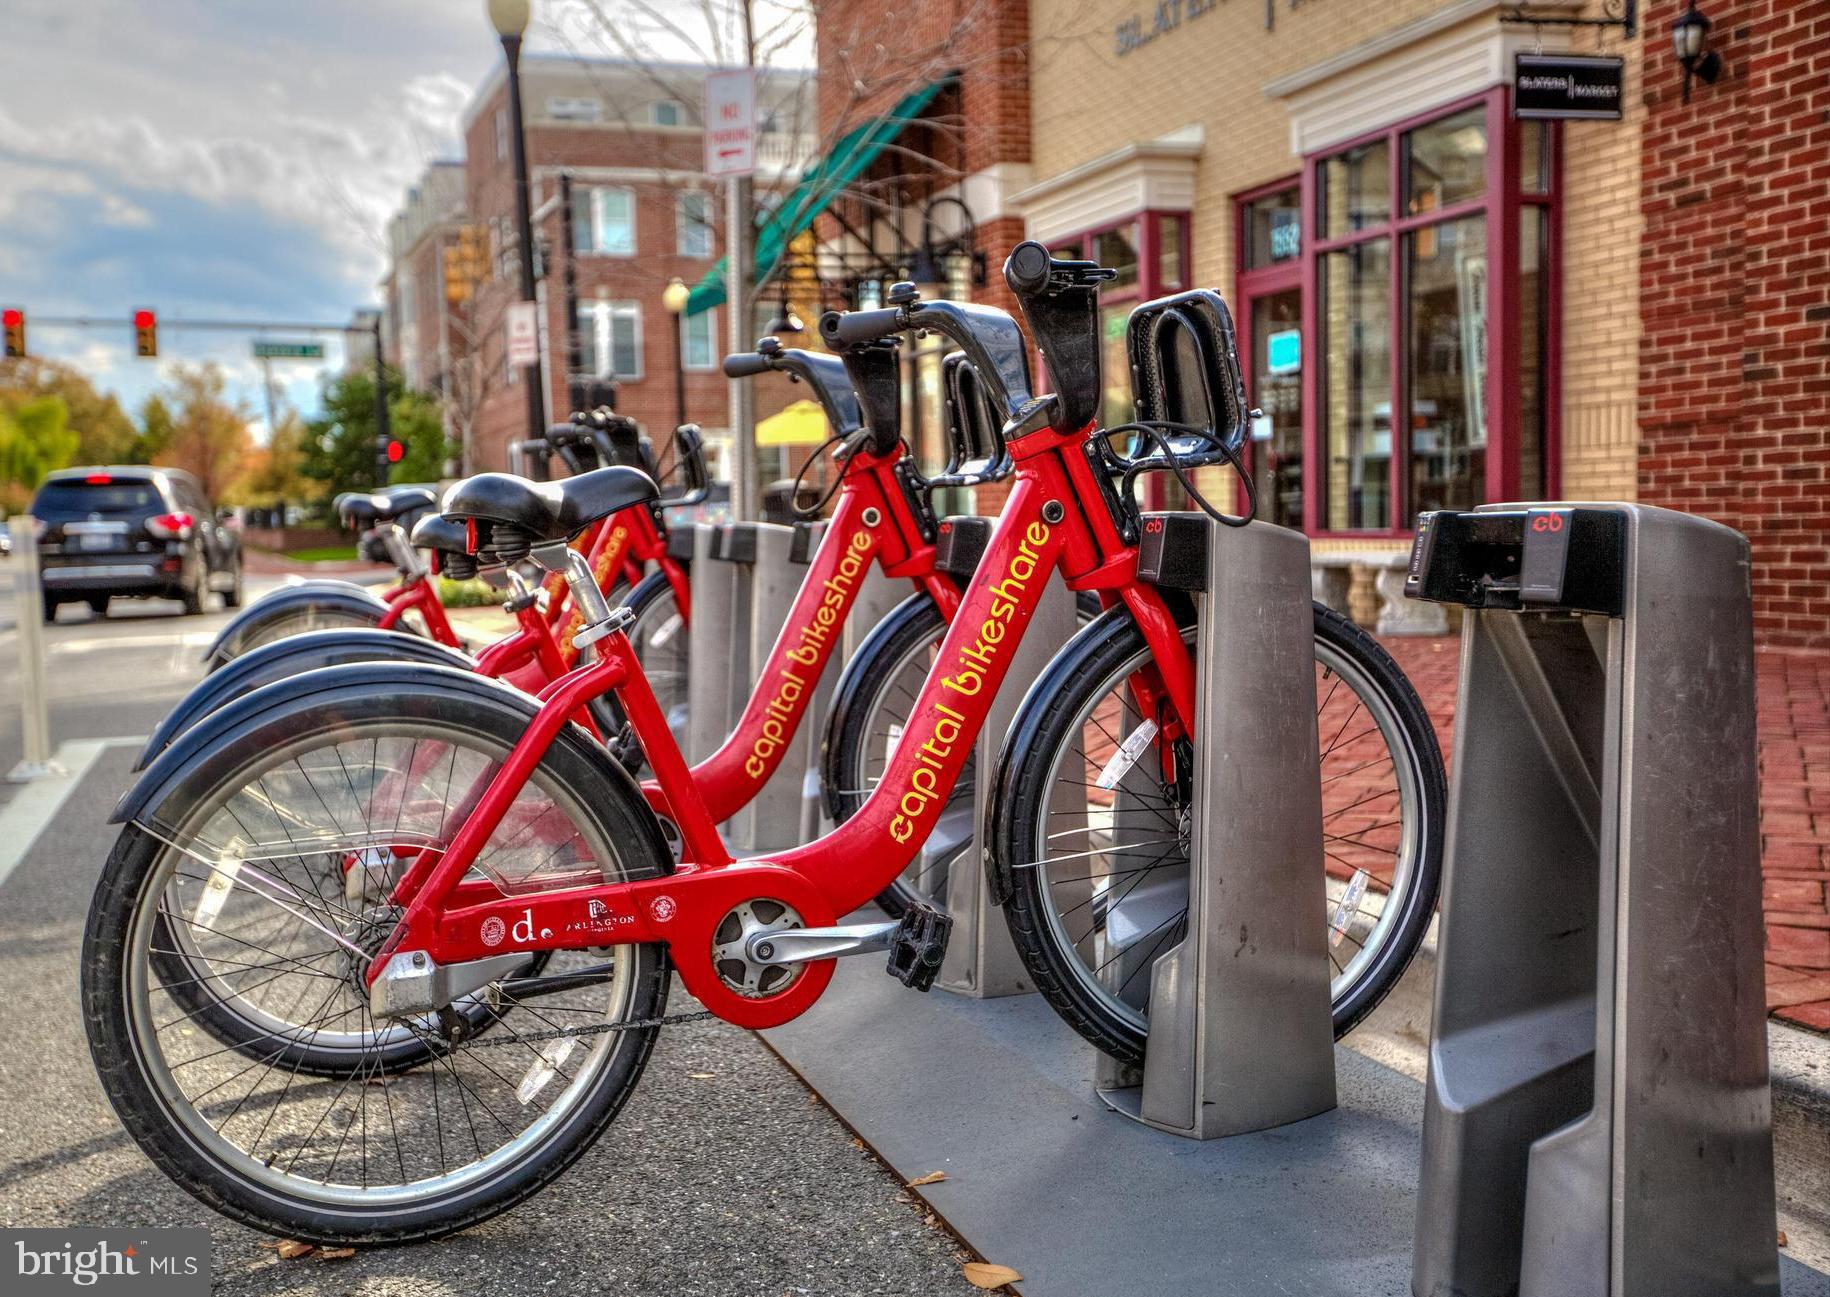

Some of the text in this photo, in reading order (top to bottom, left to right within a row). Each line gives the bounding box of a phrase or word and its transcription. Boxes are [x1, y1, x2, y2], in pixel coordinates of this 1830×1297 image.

[720, 103, 740, 120] NO
[745, 530, 872, 779] capital bikeshare
[890, 521, 1049, 844] capital bikeshare
